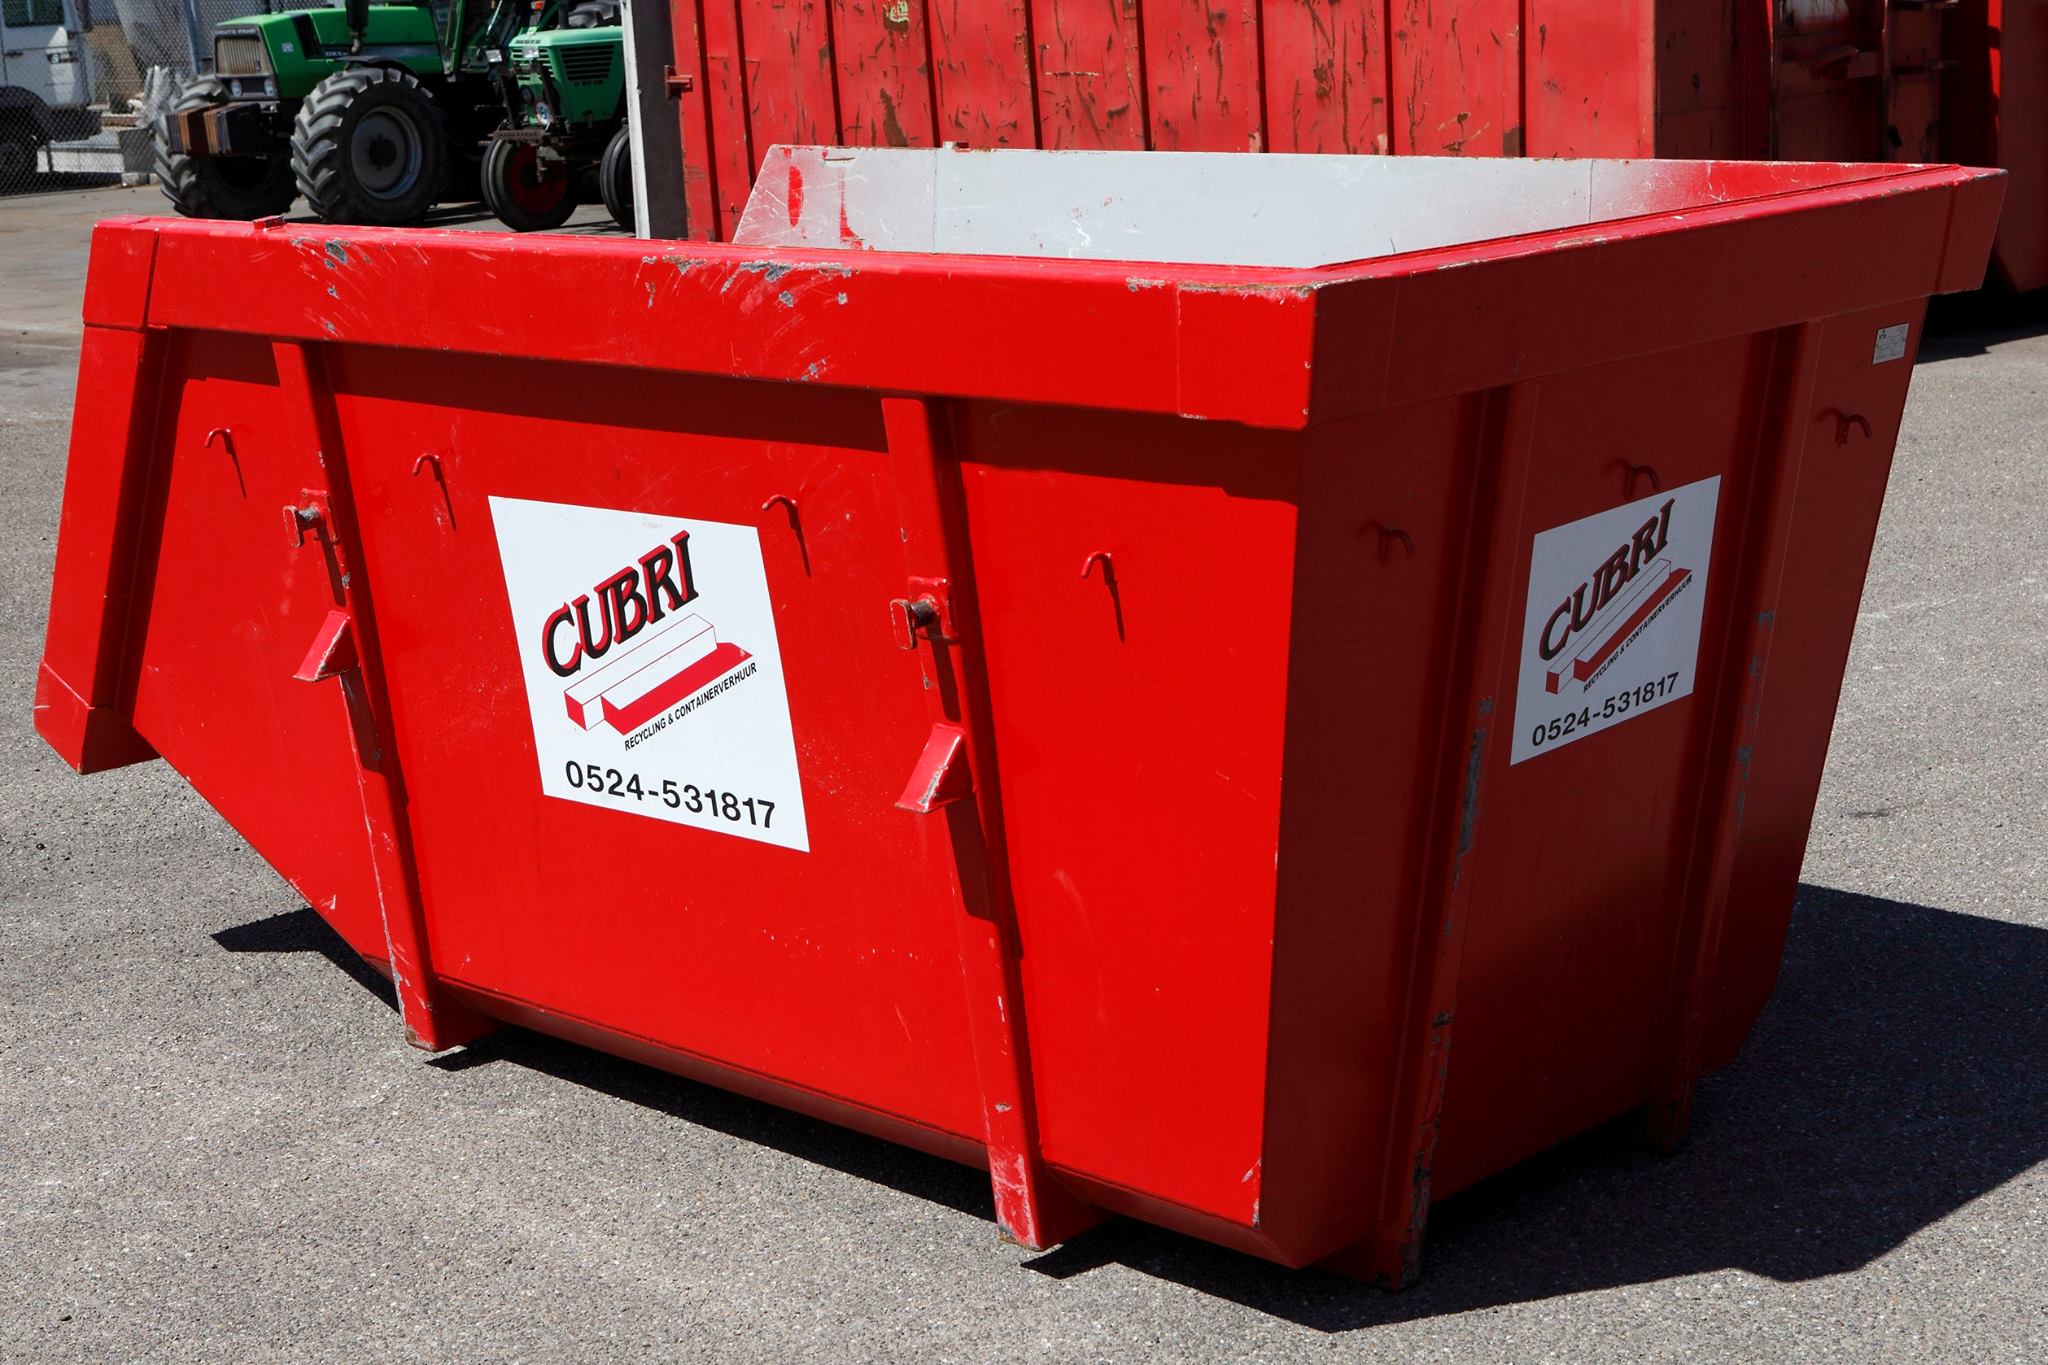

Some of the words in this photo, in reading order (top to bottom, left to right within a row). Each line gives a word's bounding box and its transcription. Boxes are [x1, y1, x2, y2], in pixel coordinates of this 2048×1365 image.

[543, 530, 698, 677] CUBRI
[1539, 498, 1675, 661] CUBRI
[624, 721, 667, 752] RECYCLING
[667, 713, 674, 724] &
[675, 661, 757, 719] CONTAINERVERHUUR
[1532, 672, 1679, 746] 0524-531817
[1583, 651, 1619, 692] RECYCLING
[565, 760, 775, 827] 0524-531817
